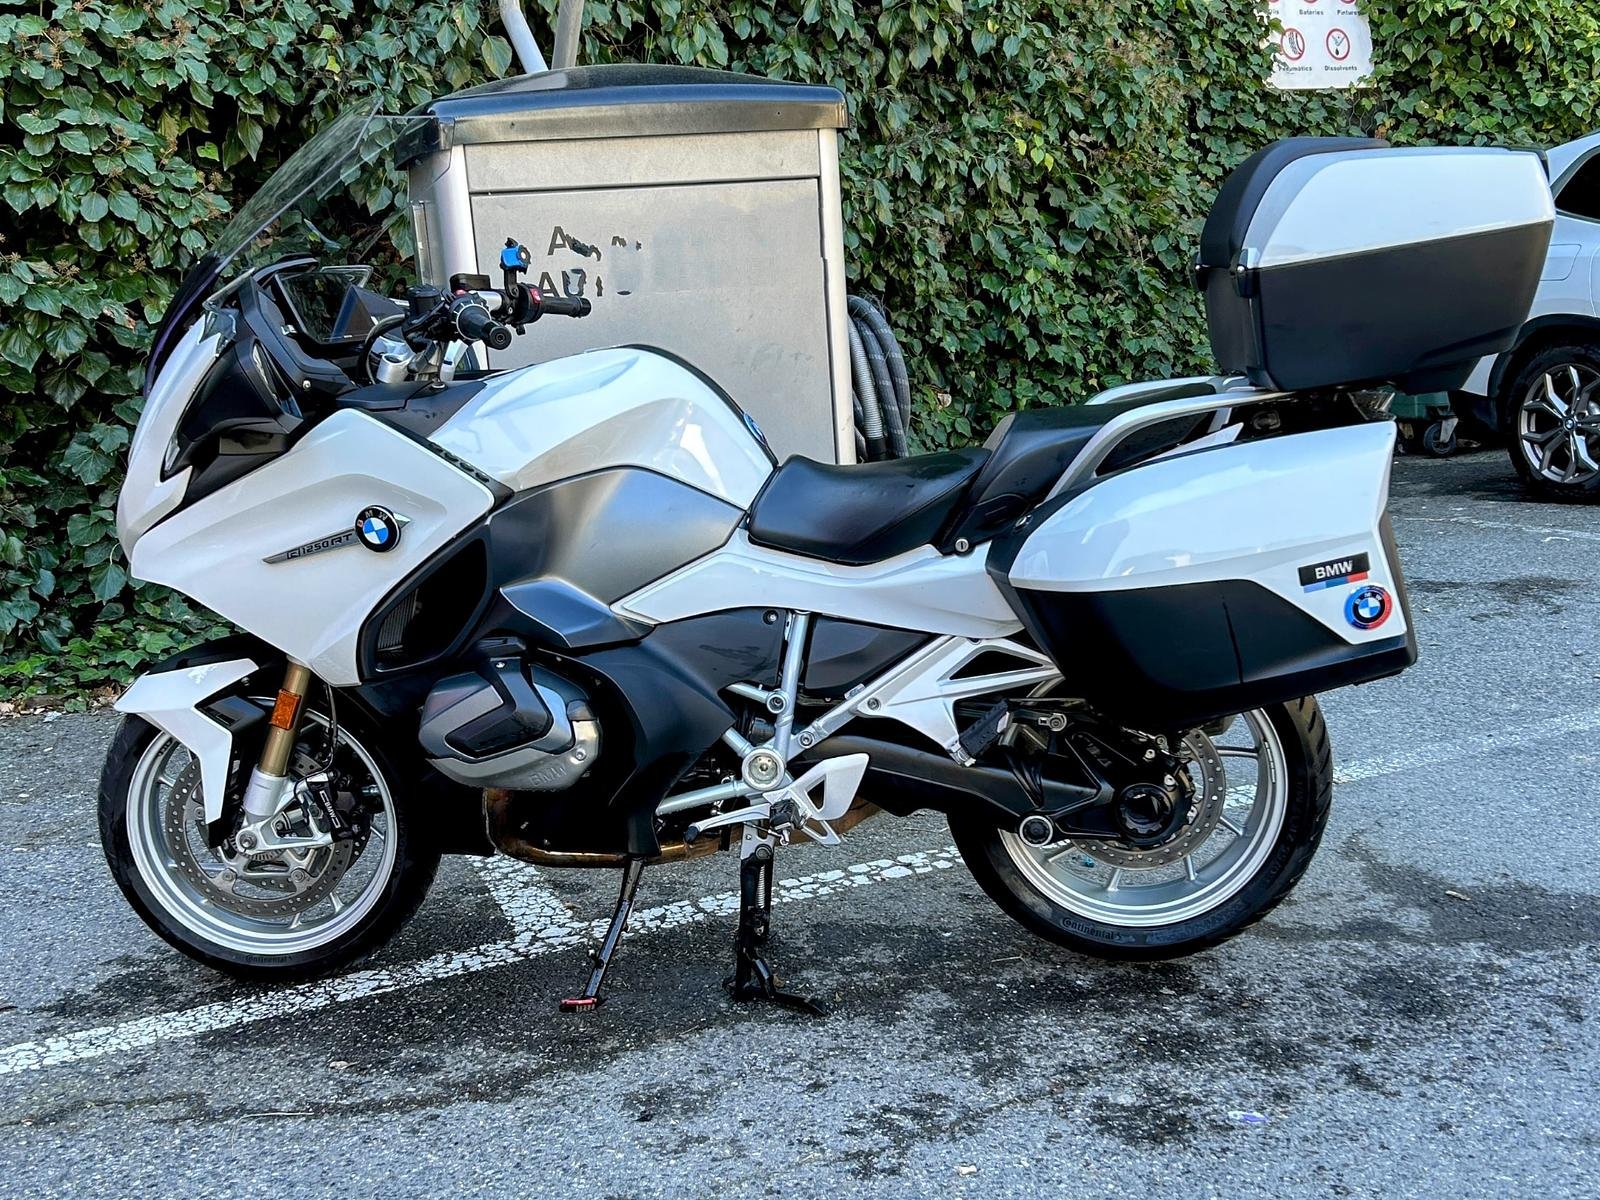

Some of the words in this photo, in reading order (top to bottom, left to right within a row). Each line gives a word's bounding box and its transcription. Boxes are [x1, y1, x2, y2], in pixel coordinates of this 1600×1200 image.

[1315, 560, 1353, 579] BMW
[529, 763, 568, 787] BMW
[324, 801, 337, 818] BMW
[1061, 917, 1116, 941] Continental
